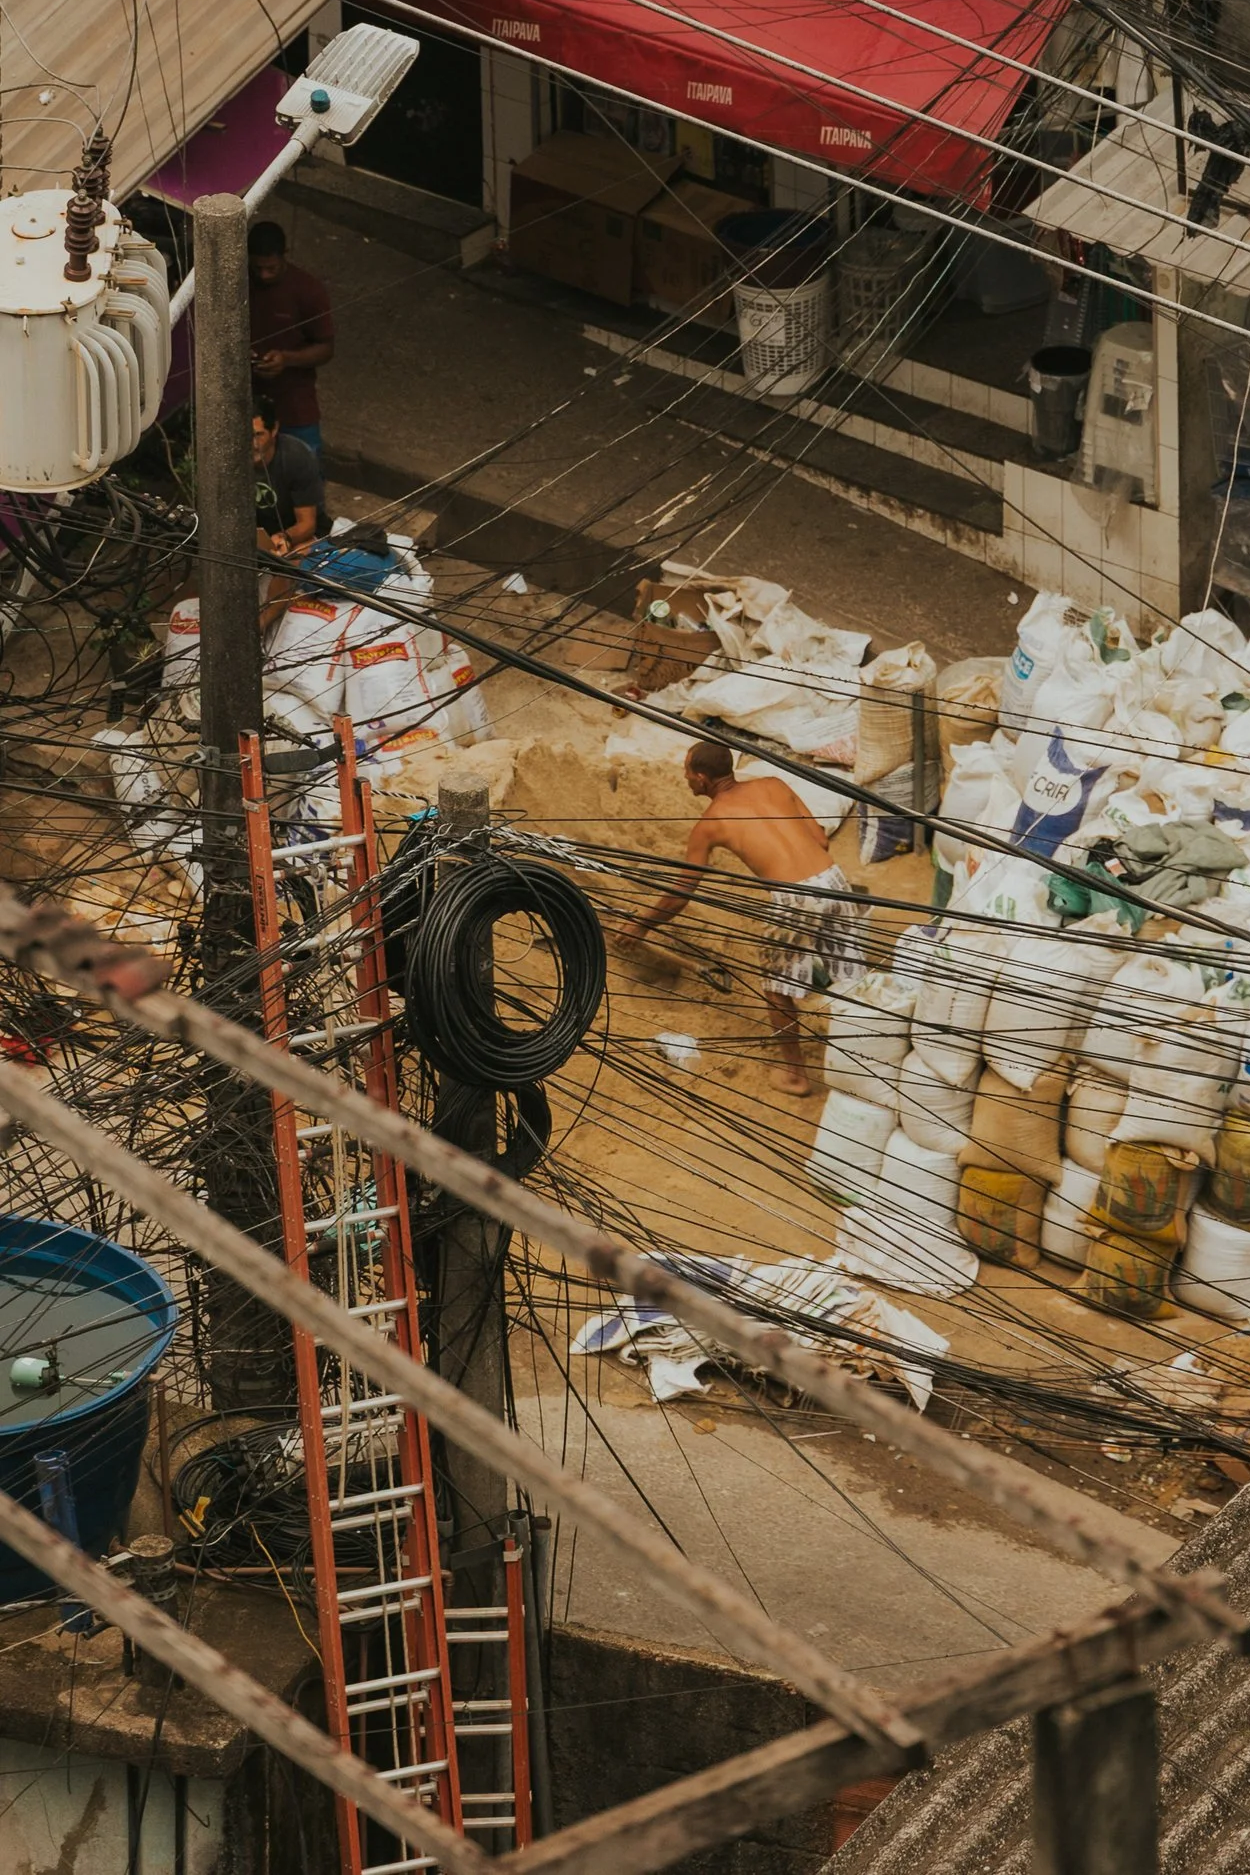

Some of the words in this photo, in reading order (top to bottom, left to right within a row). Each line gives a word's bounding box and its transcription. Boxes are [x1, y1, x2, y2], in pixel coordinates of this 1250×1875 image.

[492, 18, 541, 43] ITAIPAVA
[687, 80, 733, 106] ITAIPAVA
[820, 125, 872, 150] ITAIPAVA
